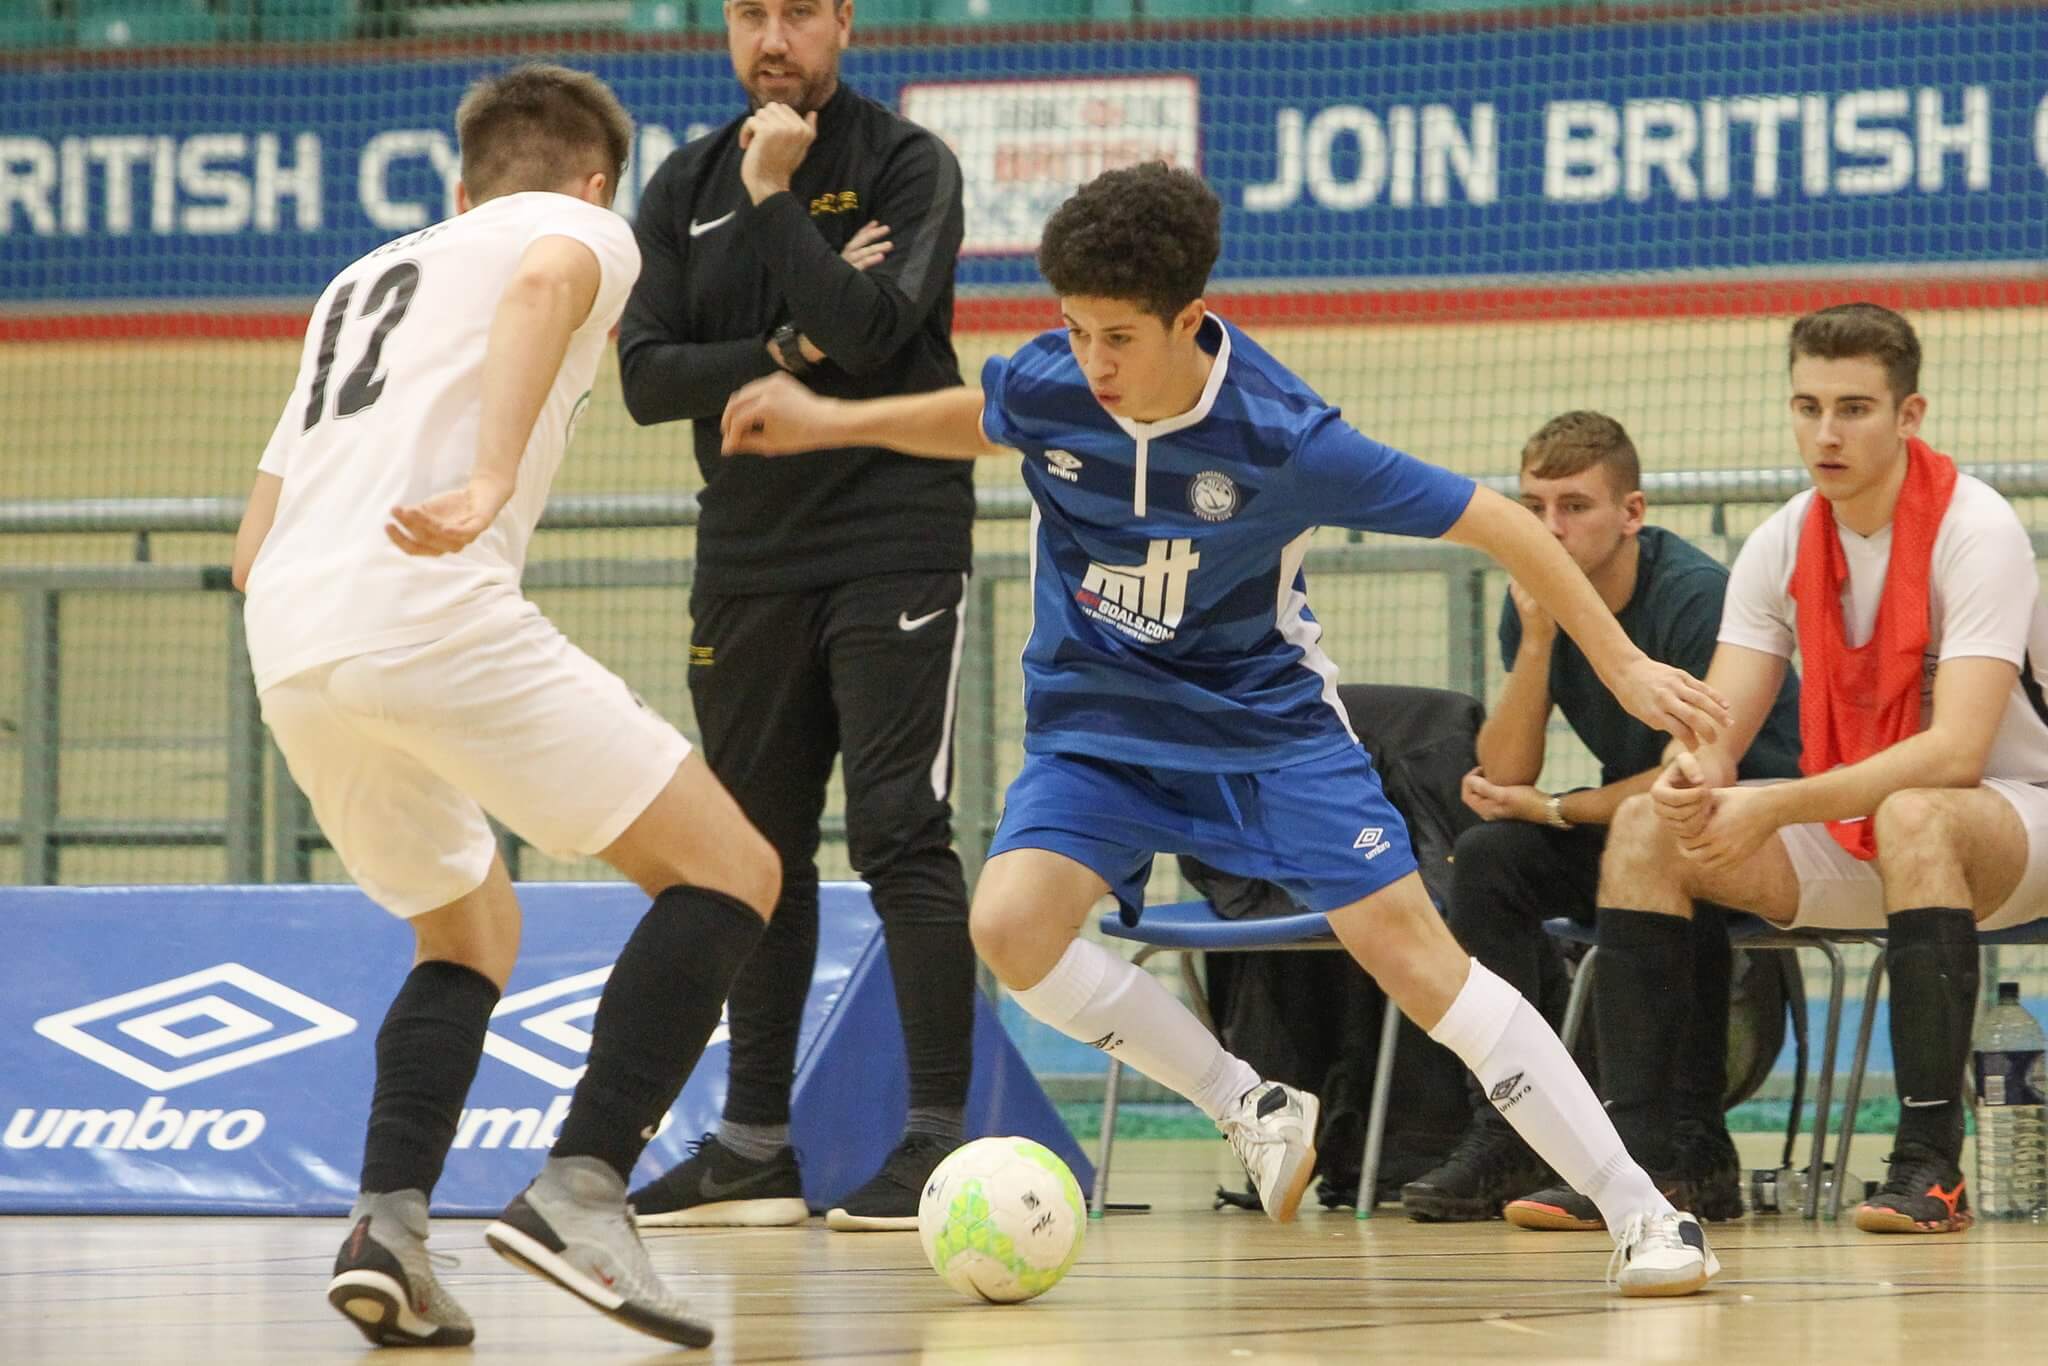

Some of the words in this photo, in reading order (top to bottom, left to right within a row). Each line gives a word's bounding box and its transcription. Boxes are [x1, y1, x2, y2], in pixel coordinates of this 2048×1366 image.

[1243, 102, 1497, 211] JOIN
[1545, 87, 1990, 201] BRITISH
[302, 259, 422, 435] 12
[3, 1096, 267, 1150] umbro
